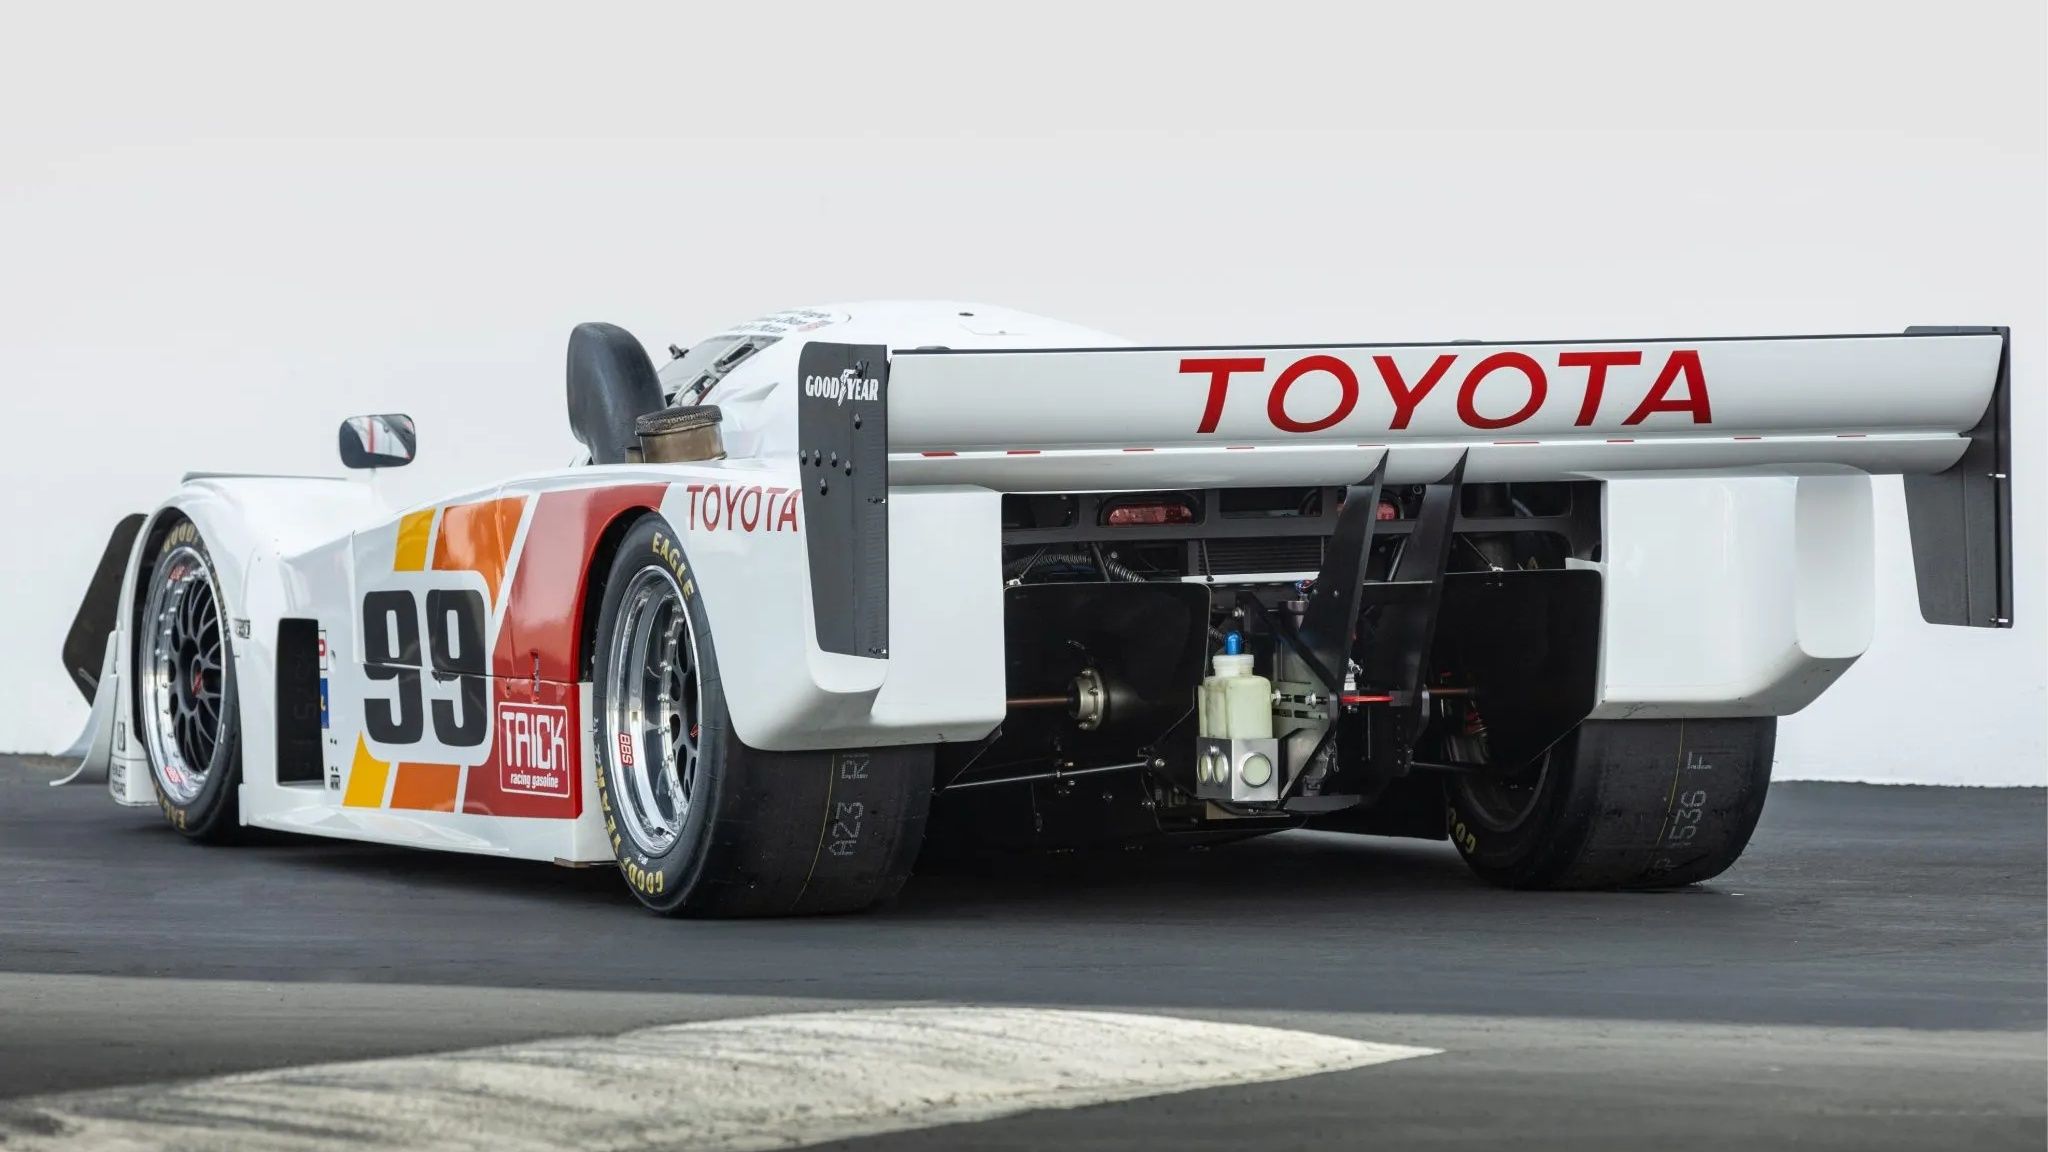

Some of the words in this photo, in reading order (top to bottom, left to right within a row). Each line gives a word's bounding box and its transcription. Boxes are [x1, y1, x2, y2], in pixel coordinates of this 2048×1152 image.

[1179, 349, 1713, 434] TOYOTA
[686, 484, 800, 532] TOYOTA
[652, 531, 695, 600] EAGLE
[362, 589, 487, 747] 99
[502, 711, 566, 771] TRICK
[620, 733, 633, 765] BBS
[510, 770, 531, 788] racing
[531, 773, 559, 789] gasoline
